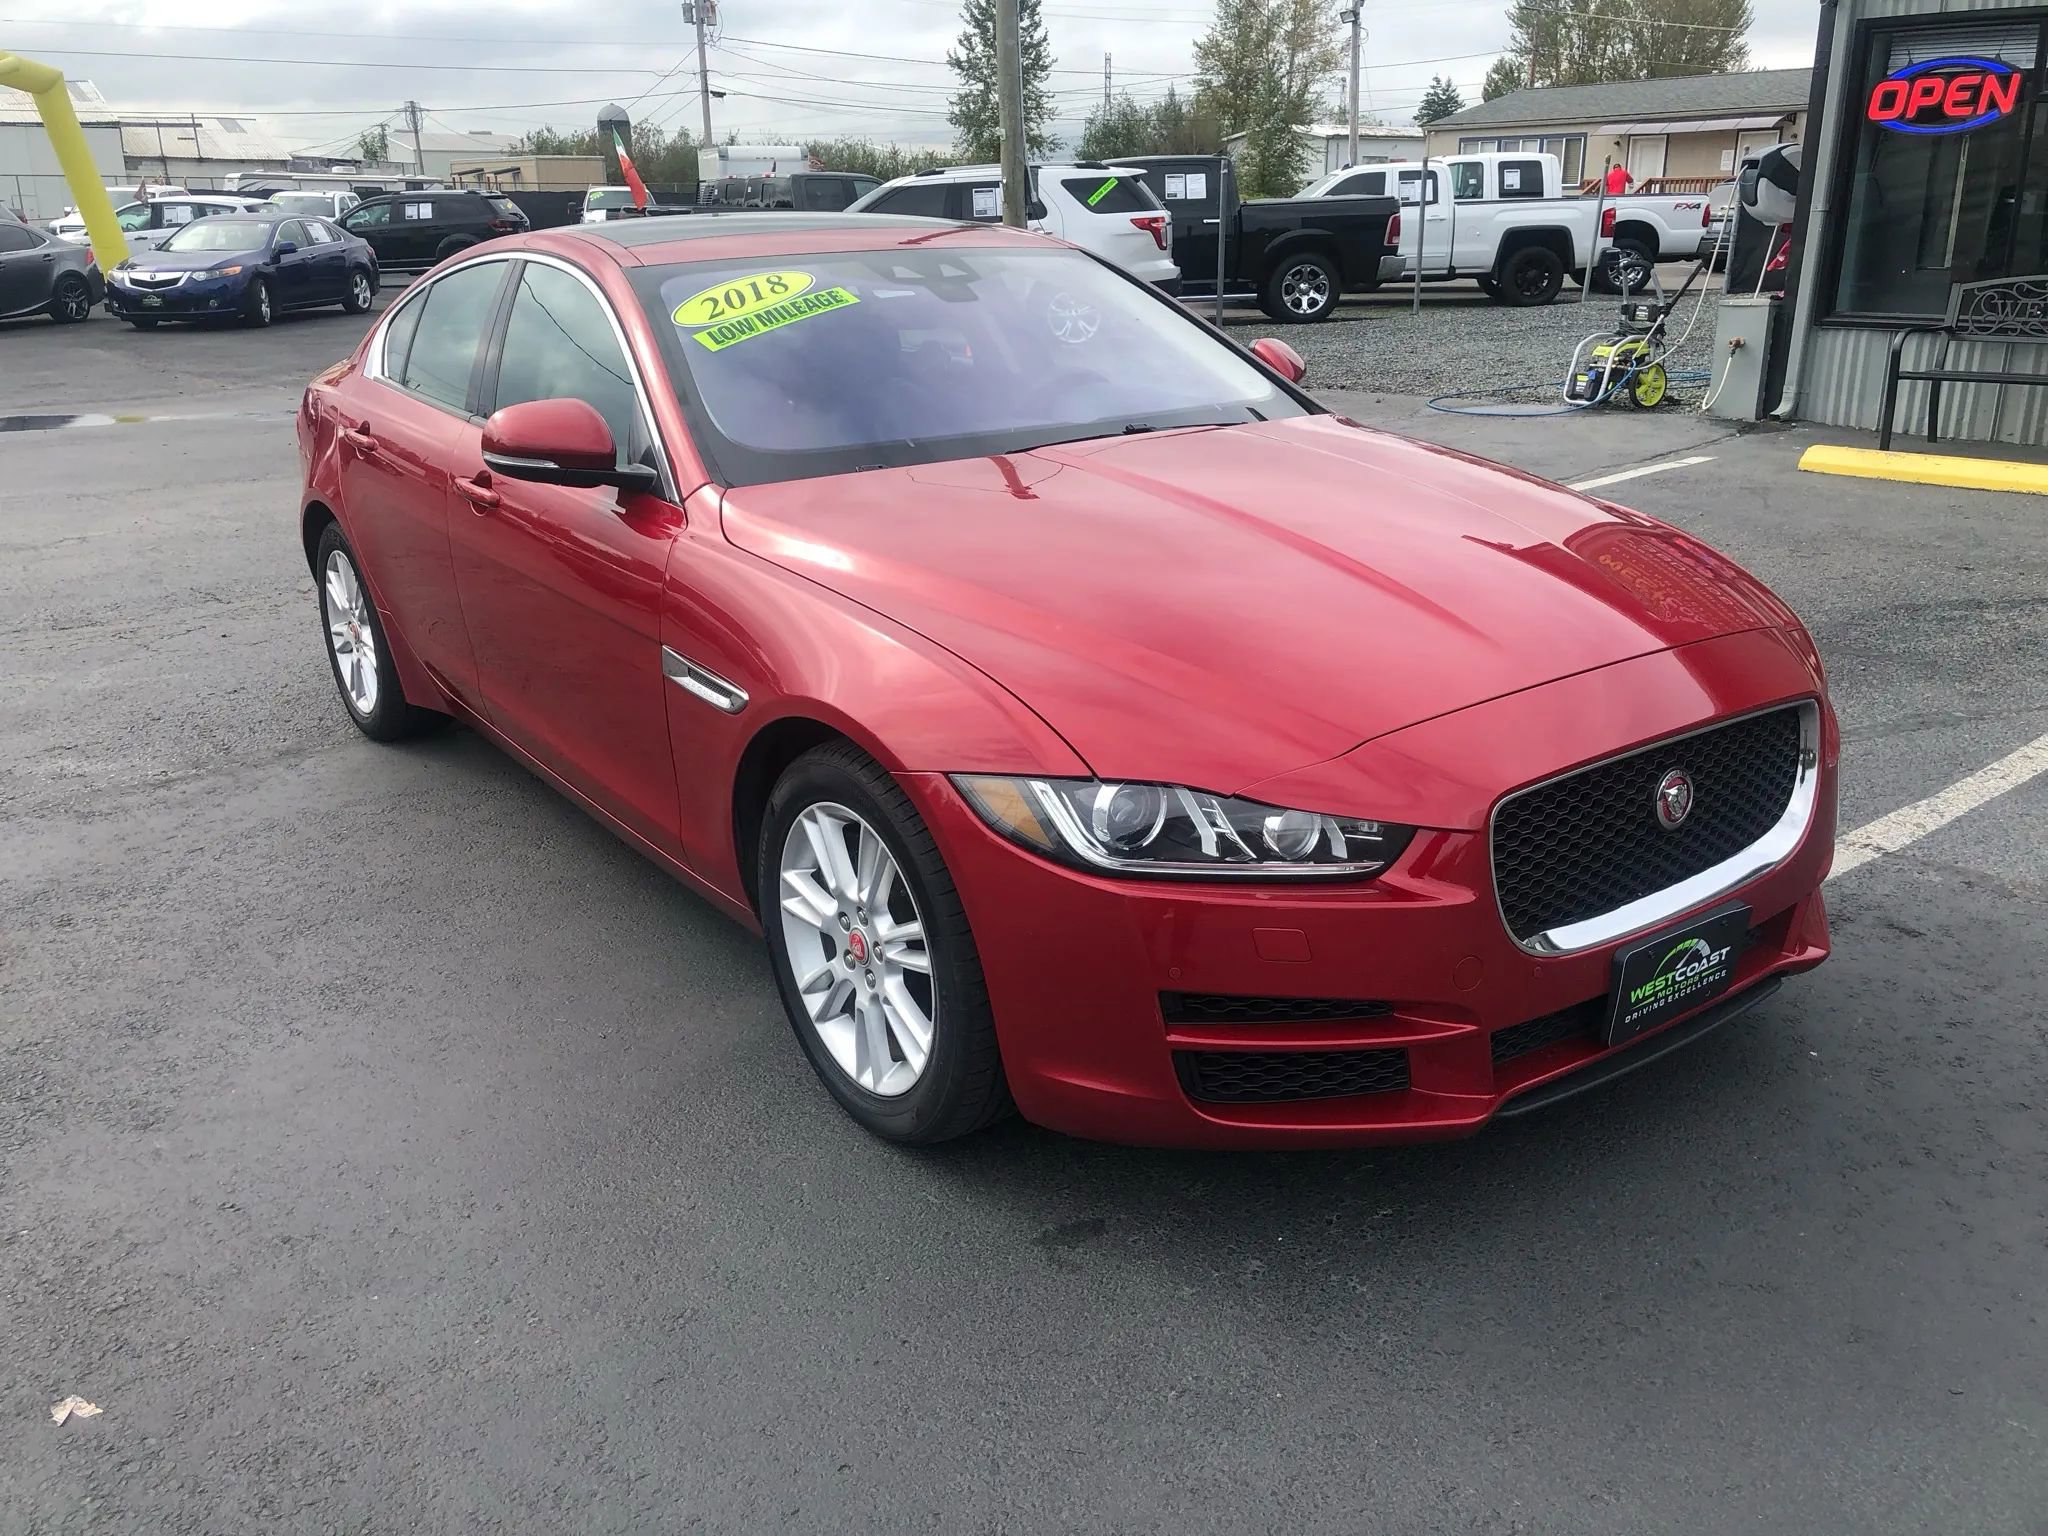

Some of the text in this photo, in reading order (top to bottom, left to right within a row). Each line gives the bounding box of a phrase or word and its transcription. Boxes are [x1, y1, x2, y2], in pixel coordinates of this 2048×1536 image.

[1868, 73, 2021, 121] OPEN
[1674, 202, 1702, 210] FX4
[701, 274, 789, 321] 2018
[706, 290, 845, 346] LOW MILEAGE
[1625, 970, 1727, 1023] DRIVING EXCELLENCE
[1657, 975, 1700, 999] MOTORS
